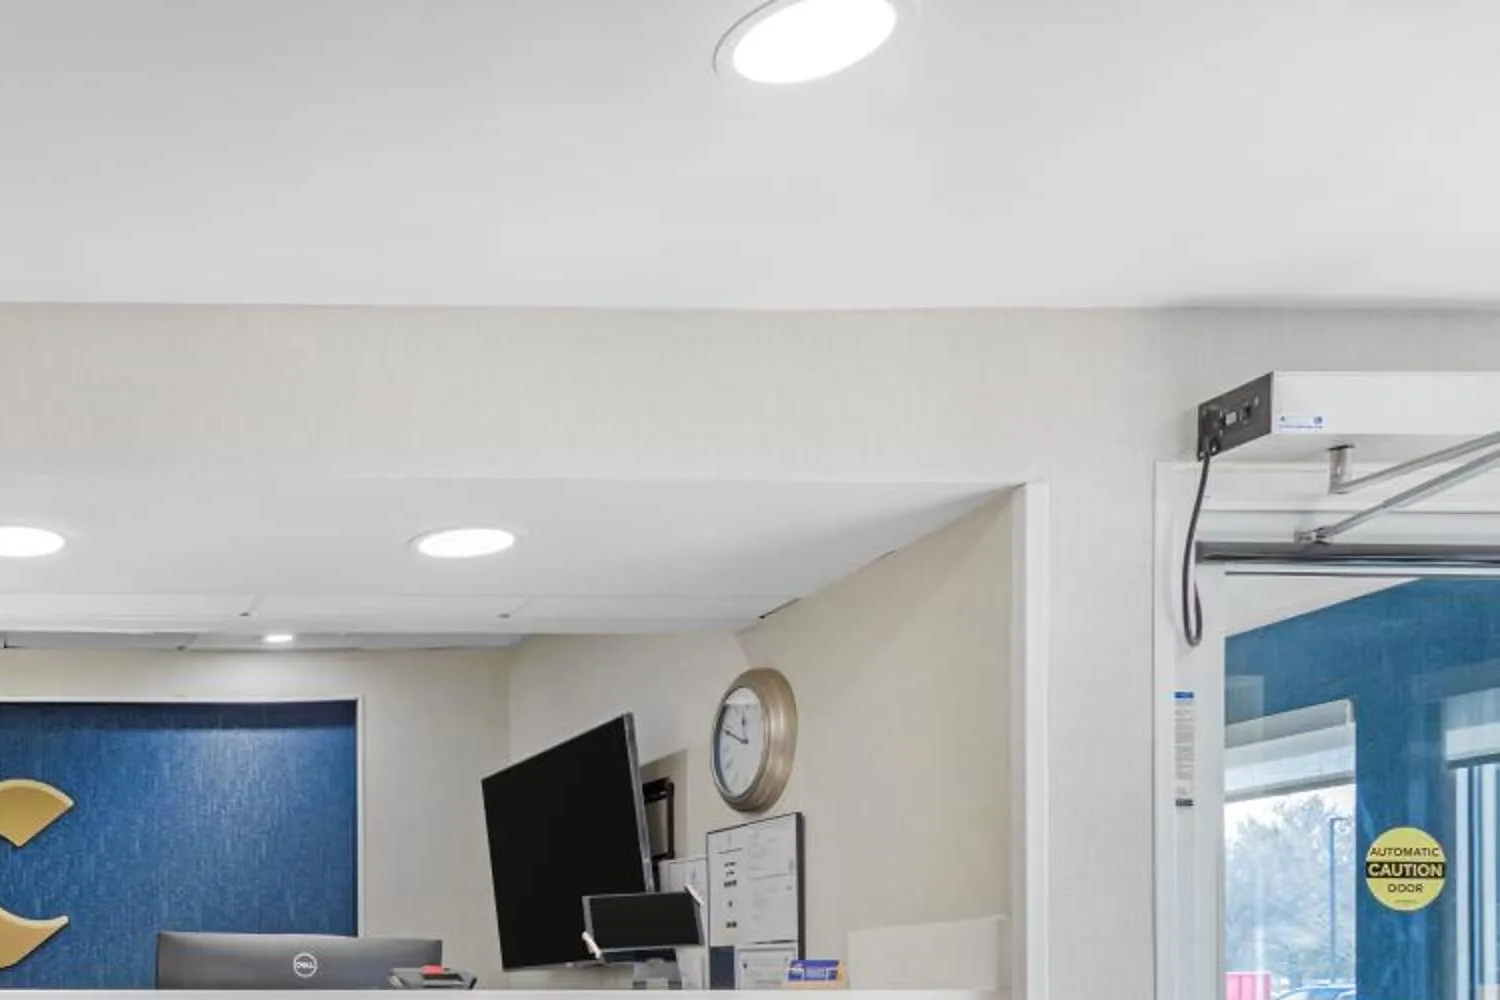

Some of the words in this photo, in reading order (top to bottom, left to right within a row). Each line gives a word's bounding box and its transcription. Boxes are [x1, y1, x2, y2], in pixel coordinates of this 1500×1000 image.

[1370, 847, 1440, 857] AUTOMATIC
[1368, 863, 1443, 877] CAUTION
[1387, 883, 1424, 893] DOOR
